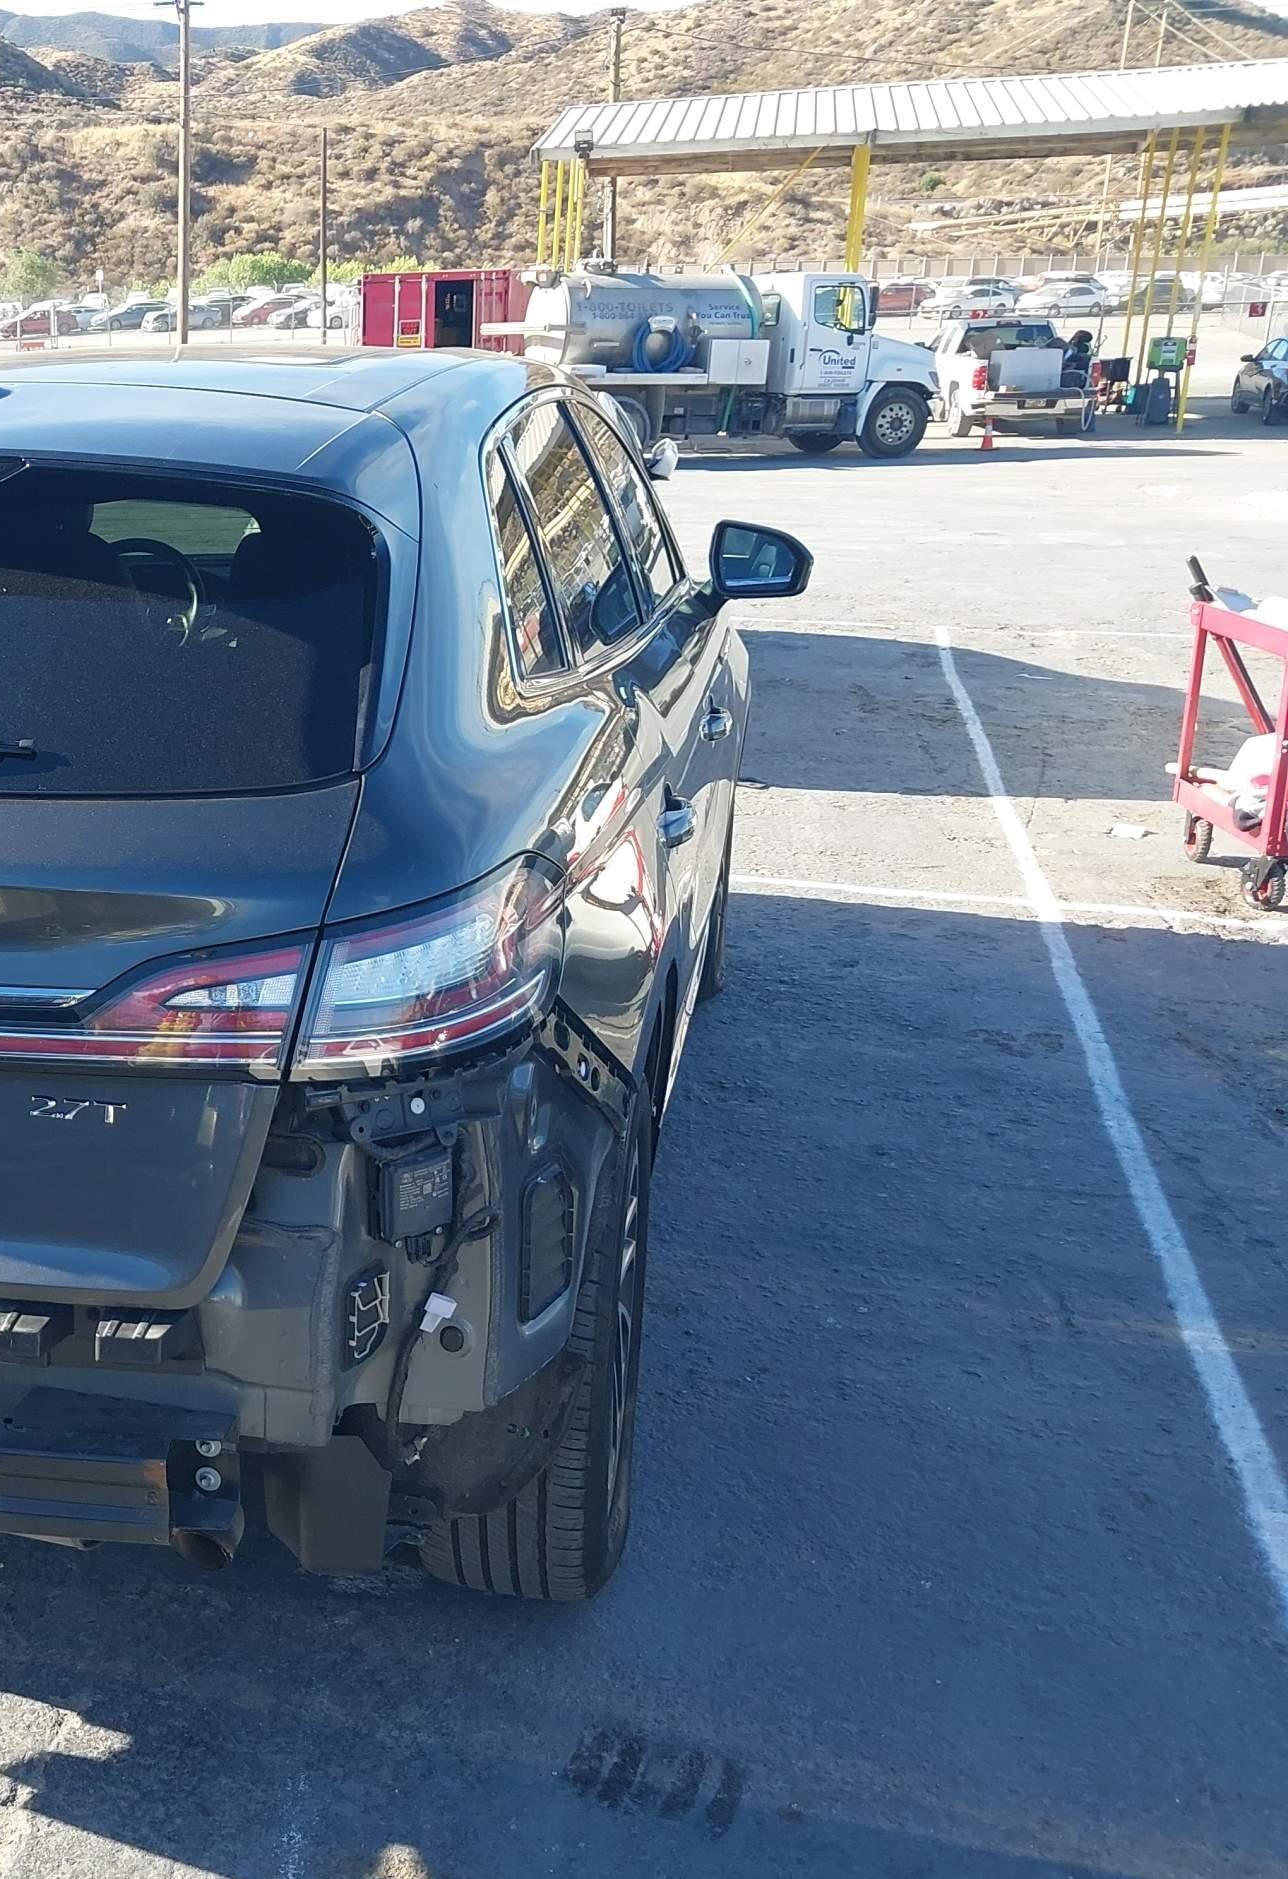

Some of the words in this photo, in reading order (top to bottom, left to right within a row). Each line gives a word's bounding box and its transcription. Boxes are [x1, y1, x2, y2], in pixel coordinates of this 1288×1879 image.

[576, 302, 674, 312] 1-800-TOILETS
[1252, 303, 1263, 315] 3
[695, 311, 712, 319] You
[714, 311, 731, 319] Can
[732, 311, 753, 319] Trus
[823, 355, 856, 365] United
[30, 1096, 127, 1124] 2.7T
